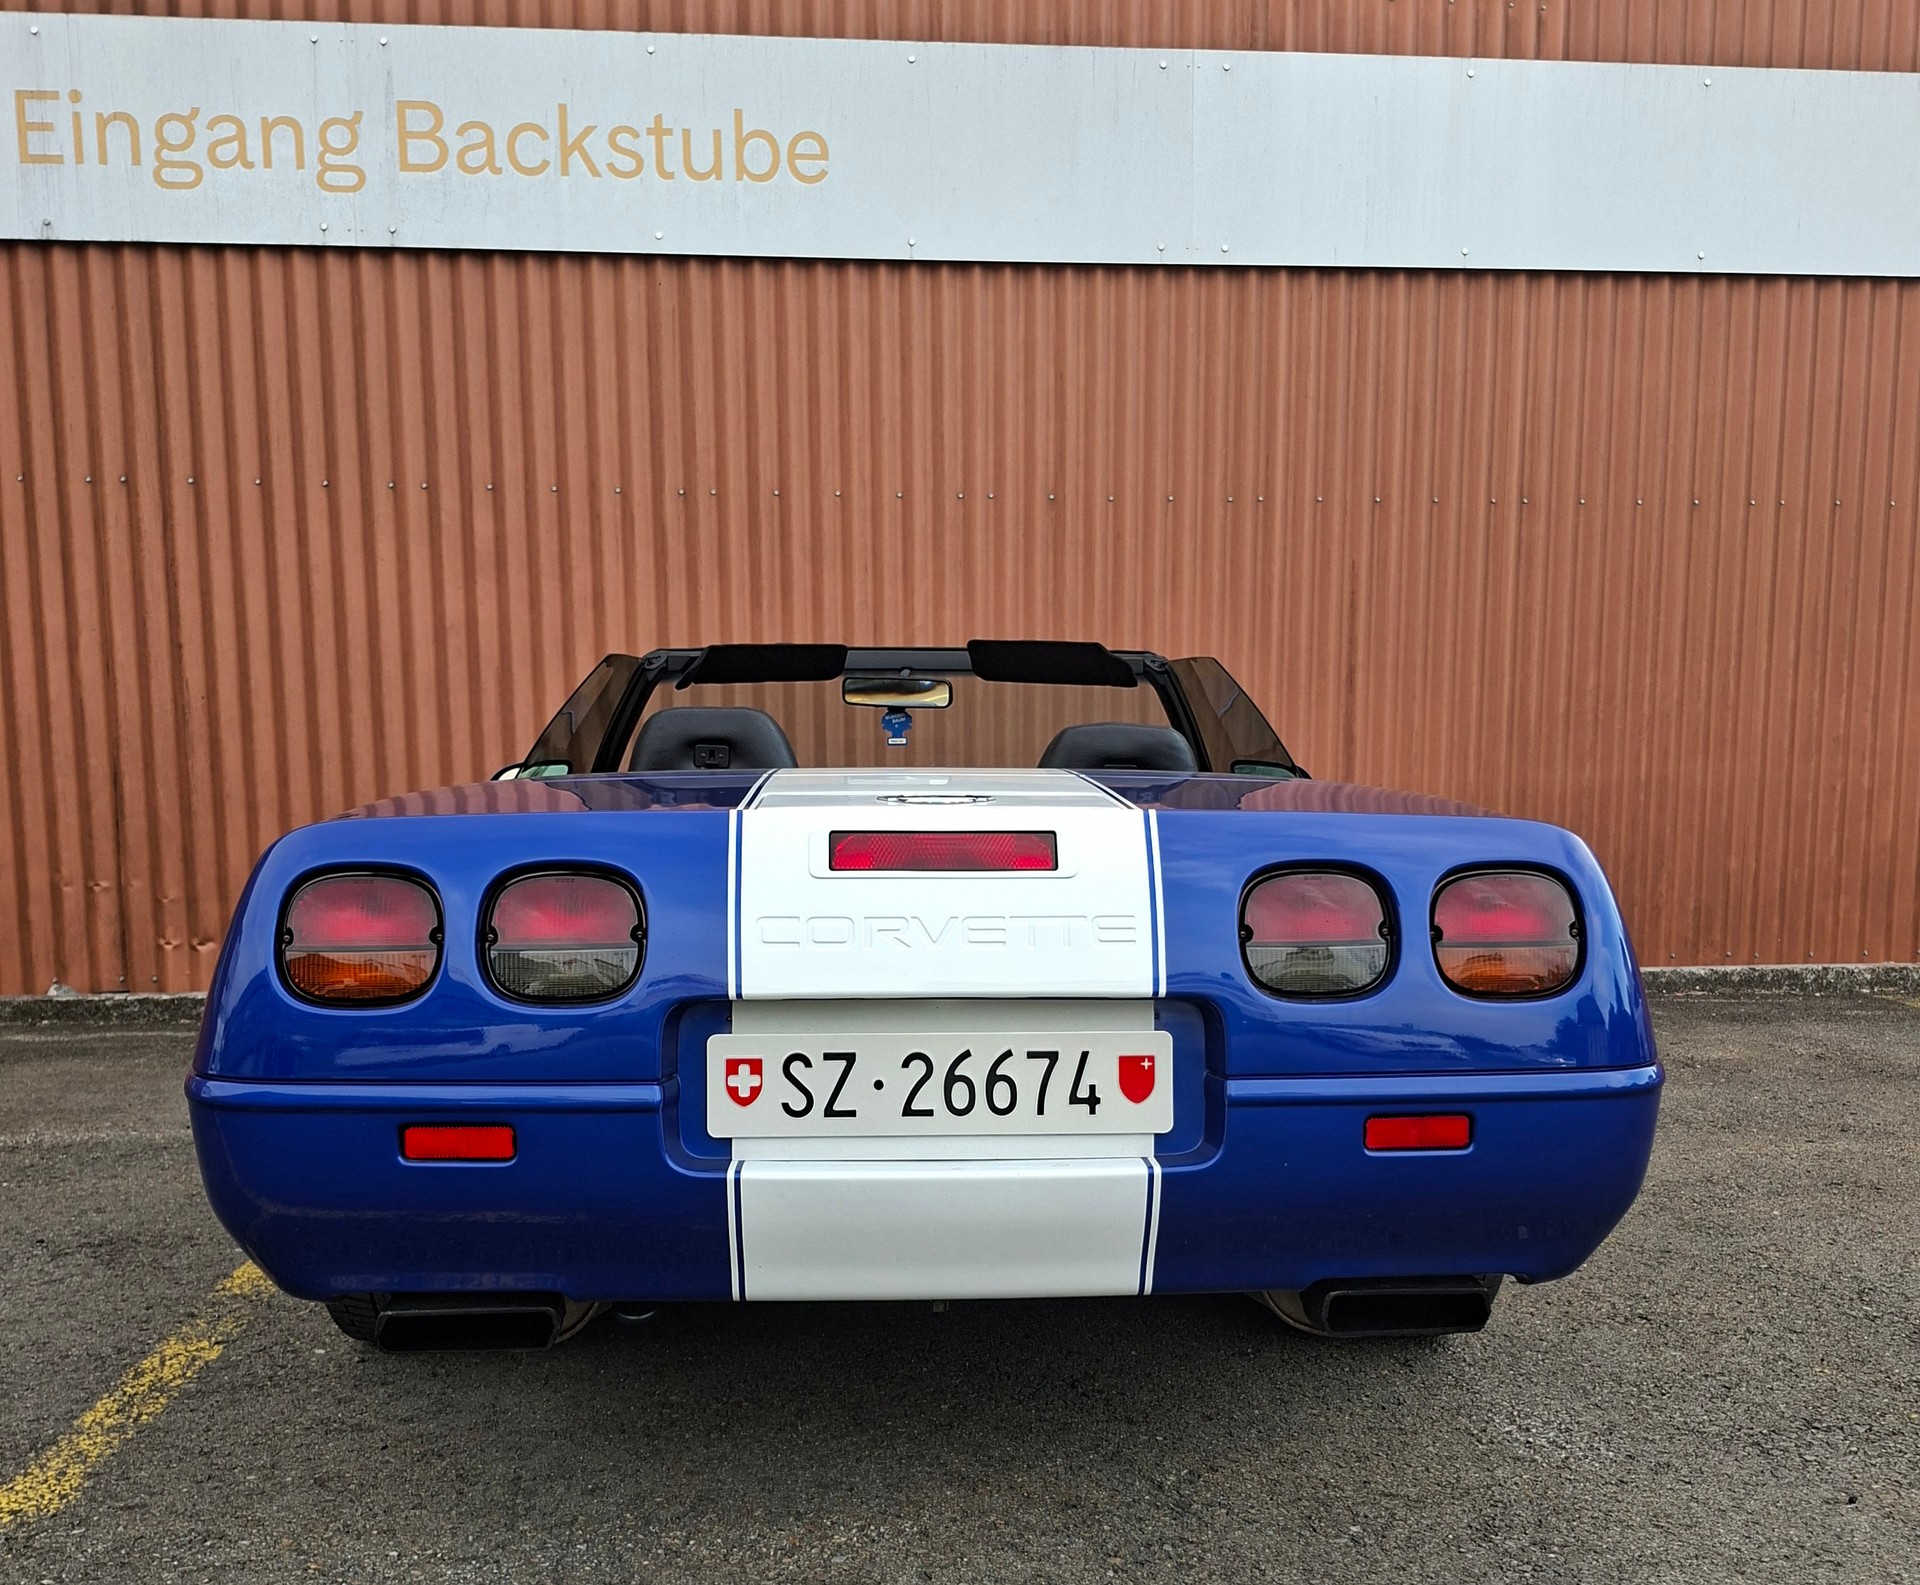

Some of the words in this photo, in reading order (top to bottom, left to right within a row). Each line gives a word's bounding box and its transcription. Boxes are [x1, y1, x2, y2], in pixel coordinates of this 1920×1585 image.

[15, 91, 365, 193] Eingang
[396, 101, 828, 184] Backstube
[755, 915, 1138, 949] CORVETTE
